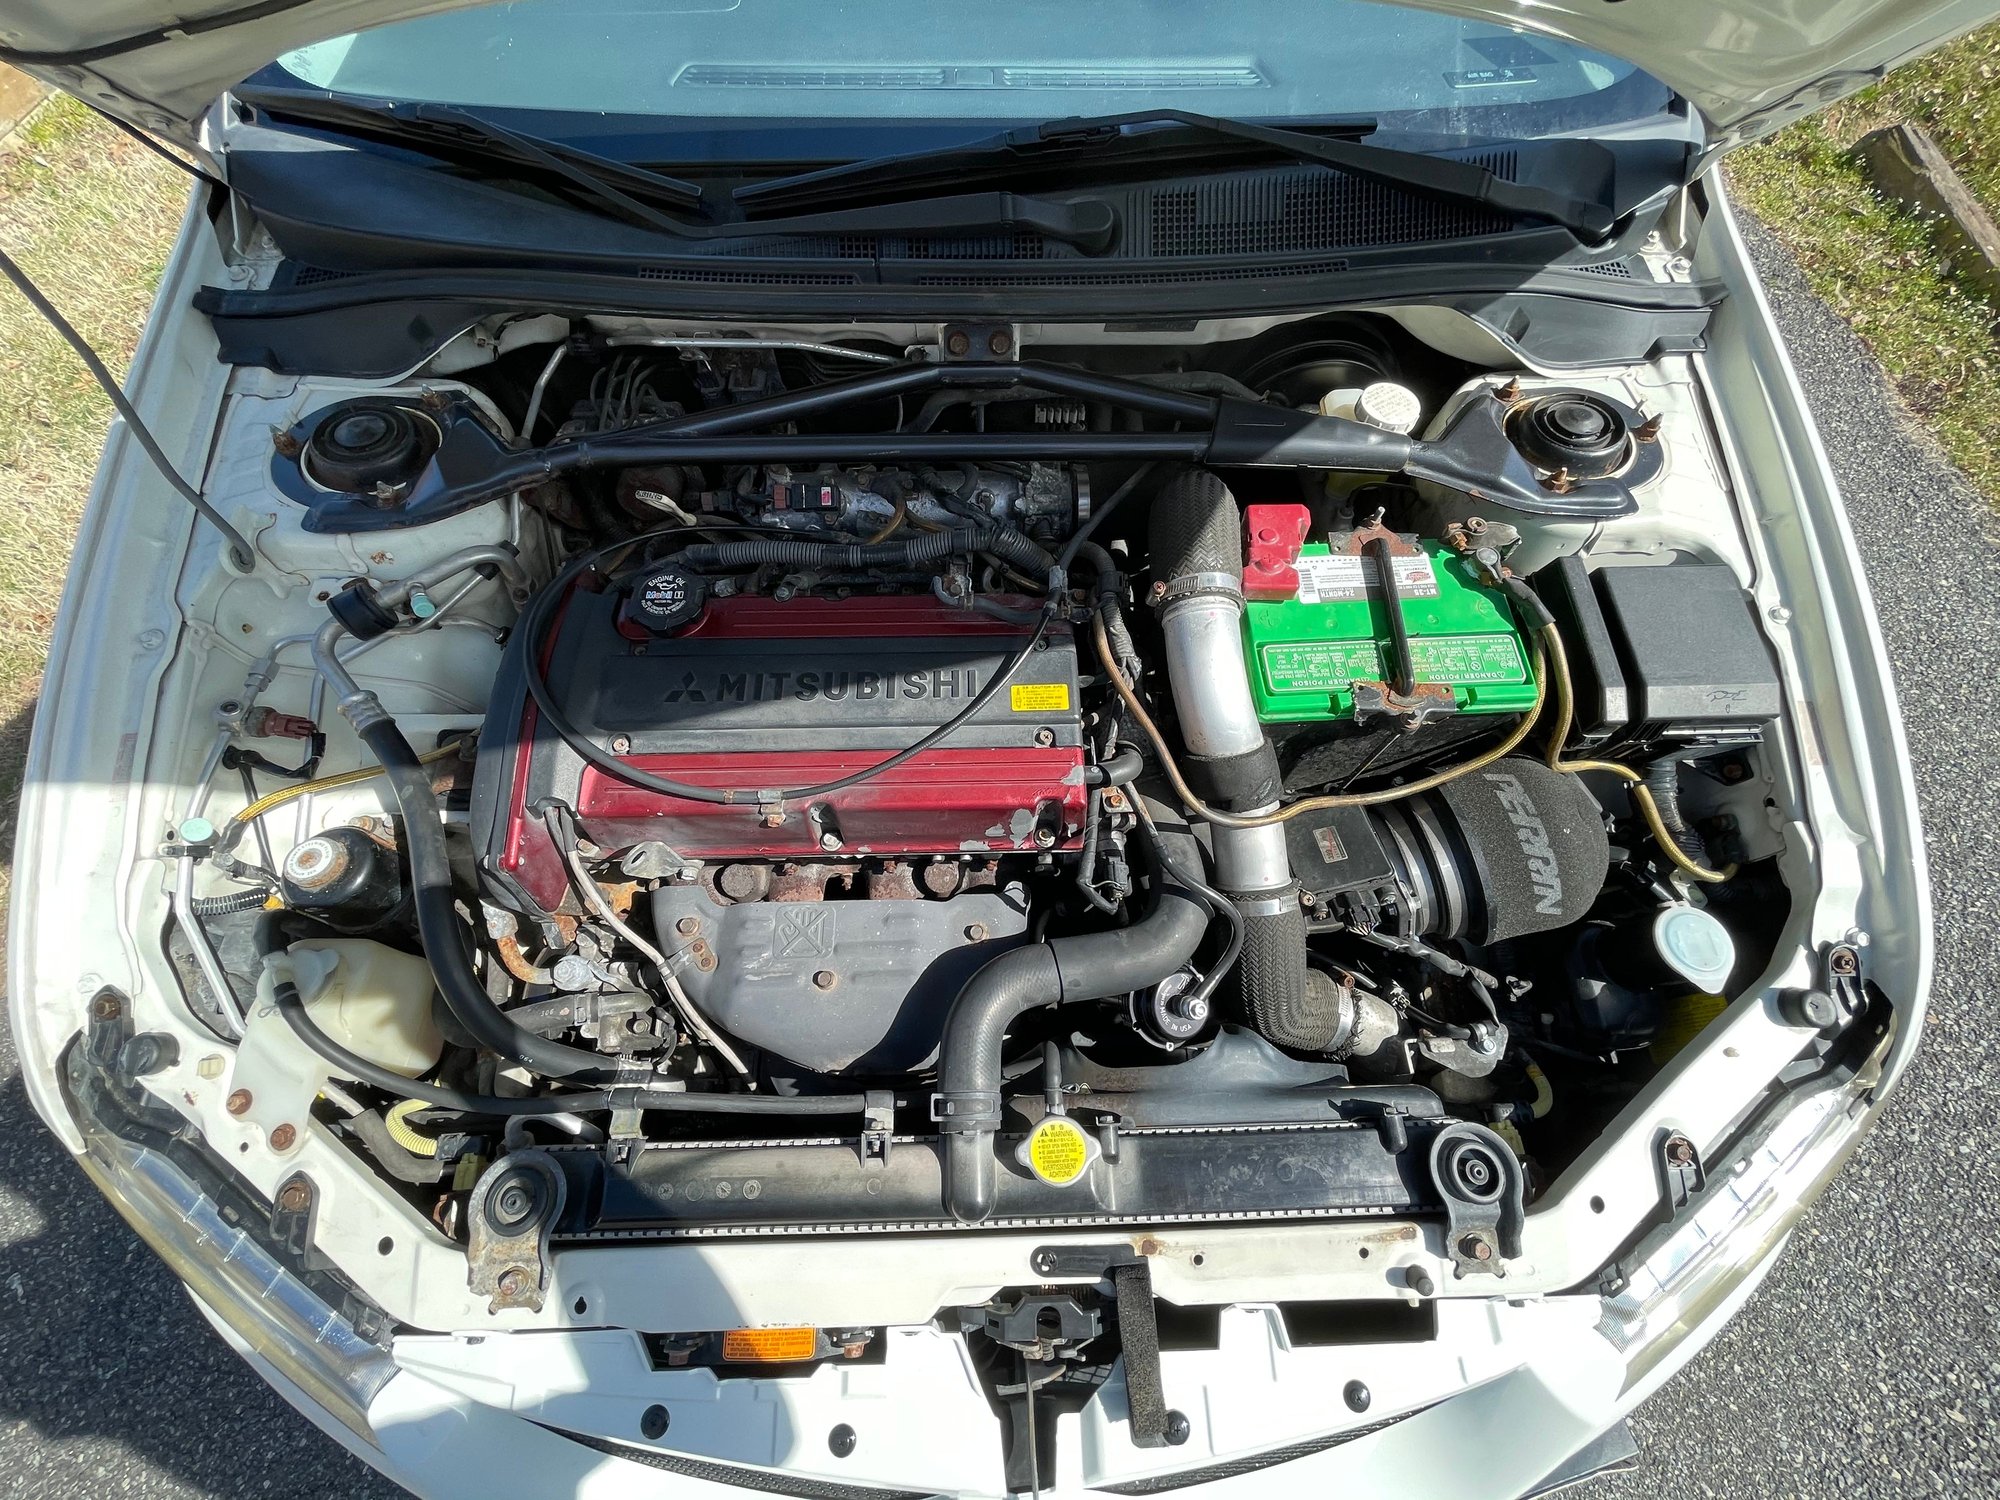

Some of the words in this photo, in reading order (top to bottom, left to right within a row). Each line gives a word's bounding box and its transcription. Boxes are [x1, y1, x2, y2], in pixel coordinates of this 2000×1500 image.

[648, 575, 674, 587] ENGINE
[675, 577, 686, 587] OIL
[645, 590, 673, 599] Mobil
[674, 590, 685, 599] 1
[1320, 590, 1355, 598] 24-MONTH
[1413, 588, 1437, 596] MT-35
[719, 669, 978, 701] MITSUBISHI
[1482, 773, 1563, 915] PERRIN
[1160, 1006, 1171, 1025] MADE
[1171, 1023, 1178, 1031] IN
[1180, 1024, 1192, 1032] USA
[1050, 1130, 1073, 1138] WARNING
[1043, 1163, 1077, 1171] AVERTISSEMENT
[1049, 1169, 1073, 1178] ACHTUNG
